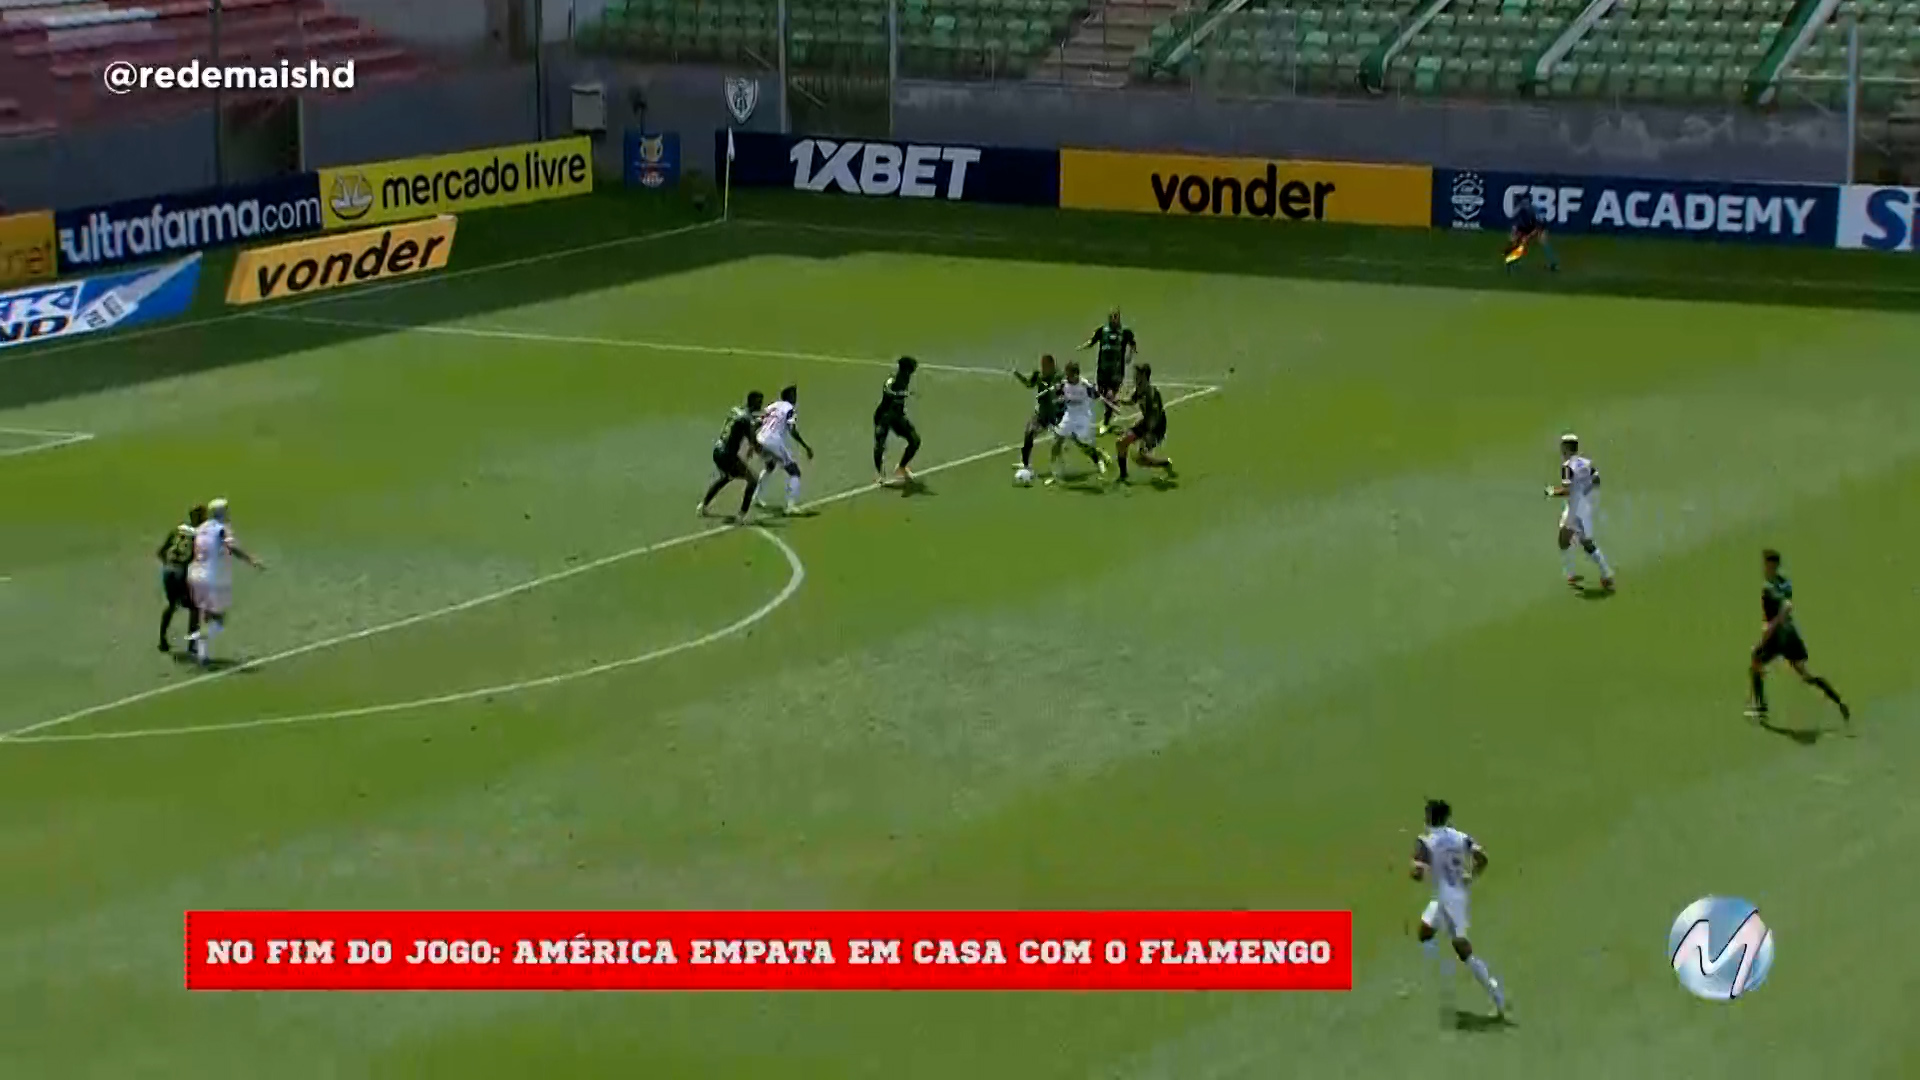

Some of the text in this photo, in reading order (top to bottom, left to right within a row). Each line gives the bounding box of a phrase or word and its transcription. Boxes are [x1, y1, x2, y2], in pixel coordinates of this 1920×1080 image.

[382, 147, 586, 210] mercado livre
[789, 138, 981, 201] 1XBET
[1151, 163, 1336, 220] vonder
[60, 196, 322, 264] ultrafarma.com
[1502, 184, 1816, 235] CBF ACADEMY
[256, 229, 445, 298] vonder
